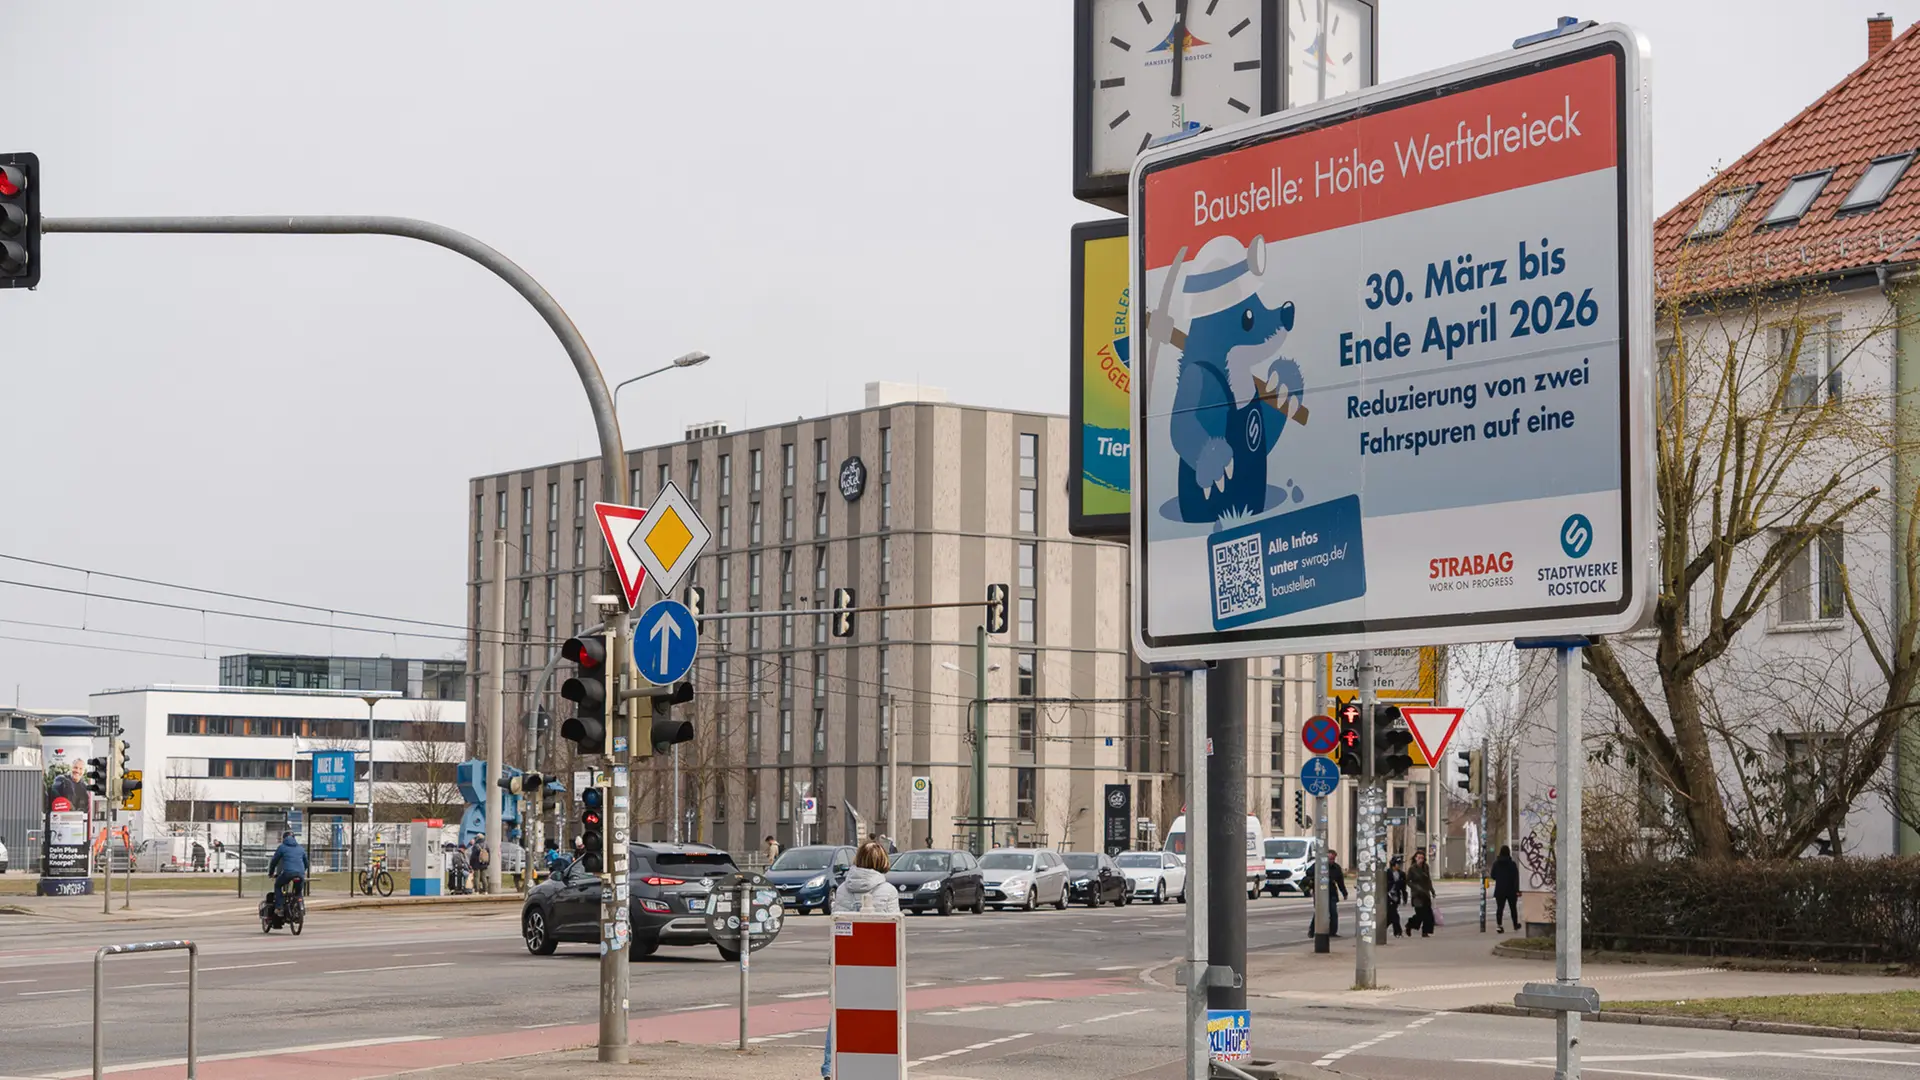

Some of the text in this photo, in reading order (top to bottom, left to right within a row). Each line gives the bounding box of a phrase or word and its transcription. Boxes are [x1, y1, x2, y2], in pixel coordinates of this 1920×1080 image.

[1184, 53, 1213, 61] ROSTOCK
[1194, 95, 1582, 226] Baustelle: Höhe Werftdreieck
[1365, 237, 1566, 310] 30. März bis
[1340, 287, 1599, 367] Ende April 2026
[1347, 357, 1589, 419] Reduzierung von zwei
[1360, 405, 1575, 456] Fahrspuren auf eine
[841, 467, 860, 489] hotel
[1268, 531, 1318, 555] Alle Infos
[1270, 542, 1348, 576] unter swrag.de/
[1429, 551, 1514, 579] STRABAG
[1537, 562, 1618, 581] STADTWERKE
[1271, 575, 1316, 597] baustellen
[1429, 577, 1513, 592] WORK ON PROGRESS
[1548, 579, 1606, 597] ROSTOCK
